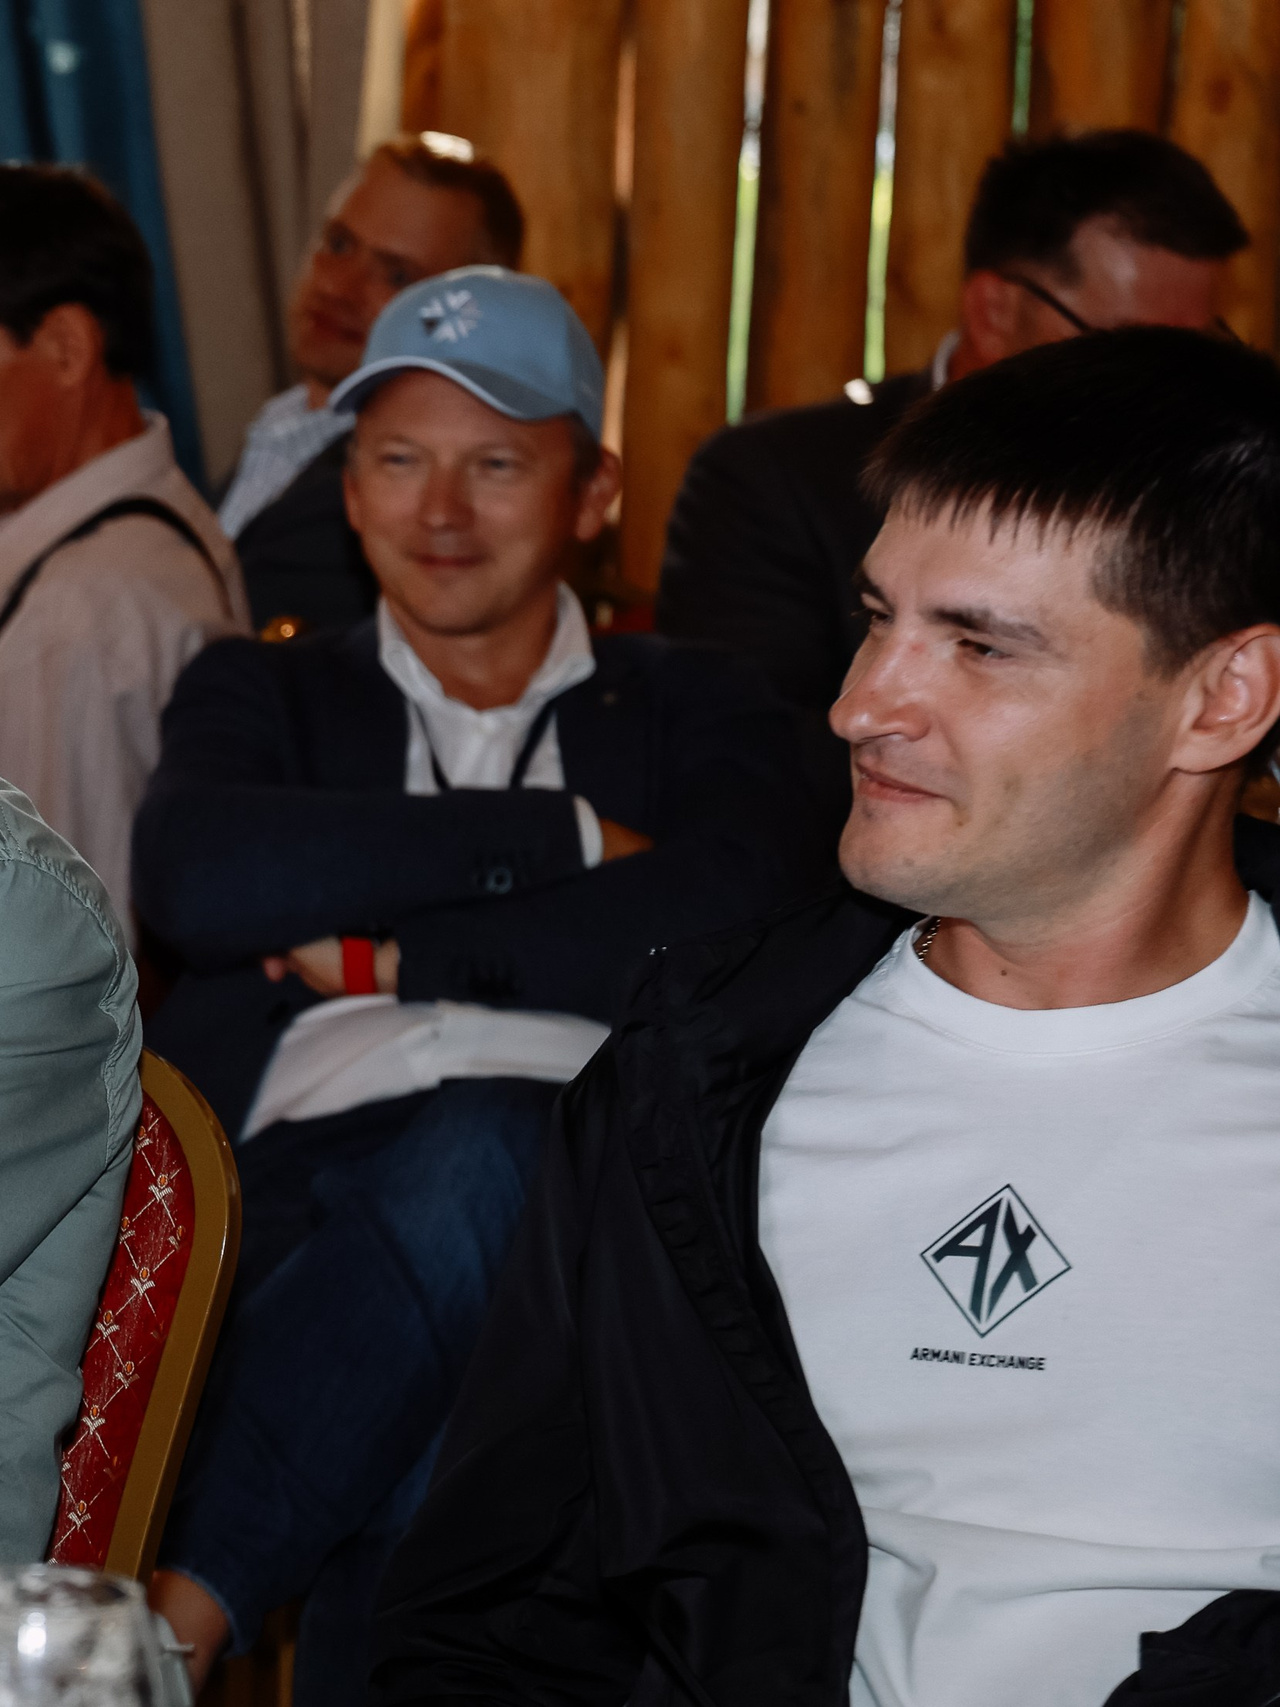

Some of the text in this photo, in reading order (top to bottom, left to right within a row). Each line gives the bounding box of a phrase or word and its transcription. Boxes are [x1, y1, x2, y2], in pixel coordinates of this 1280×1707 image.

[932, 1197, 1039, 1323] AX
[909, 1347, 1046, 1371] ARMANI EXCHANGE
